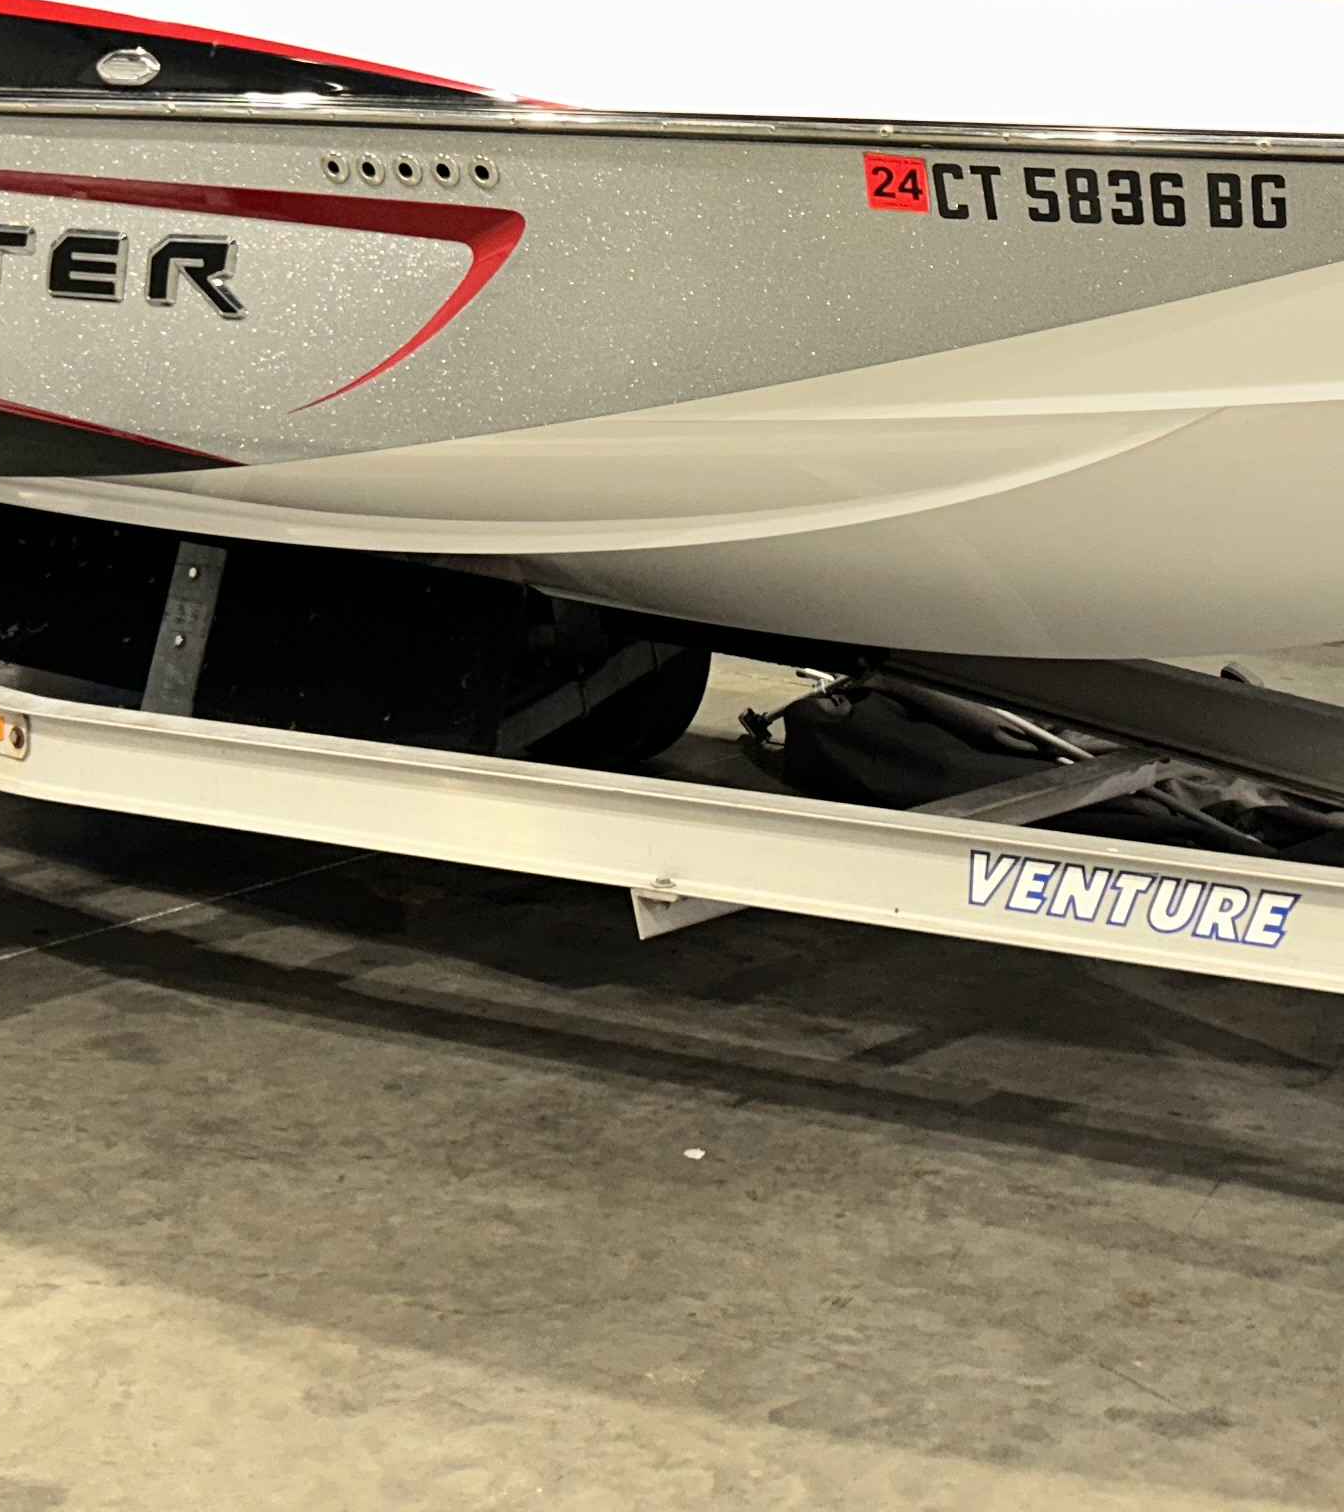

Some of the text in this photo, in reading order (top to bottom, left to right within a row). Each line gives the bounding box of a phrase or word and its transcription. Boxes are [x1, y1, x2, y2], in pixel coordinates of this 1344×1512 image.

[871, 166, 923, 200] 24
[932, 163, 1288, 228] CT 5836 BG
[968, 849, 1302, 949] VENTURE
